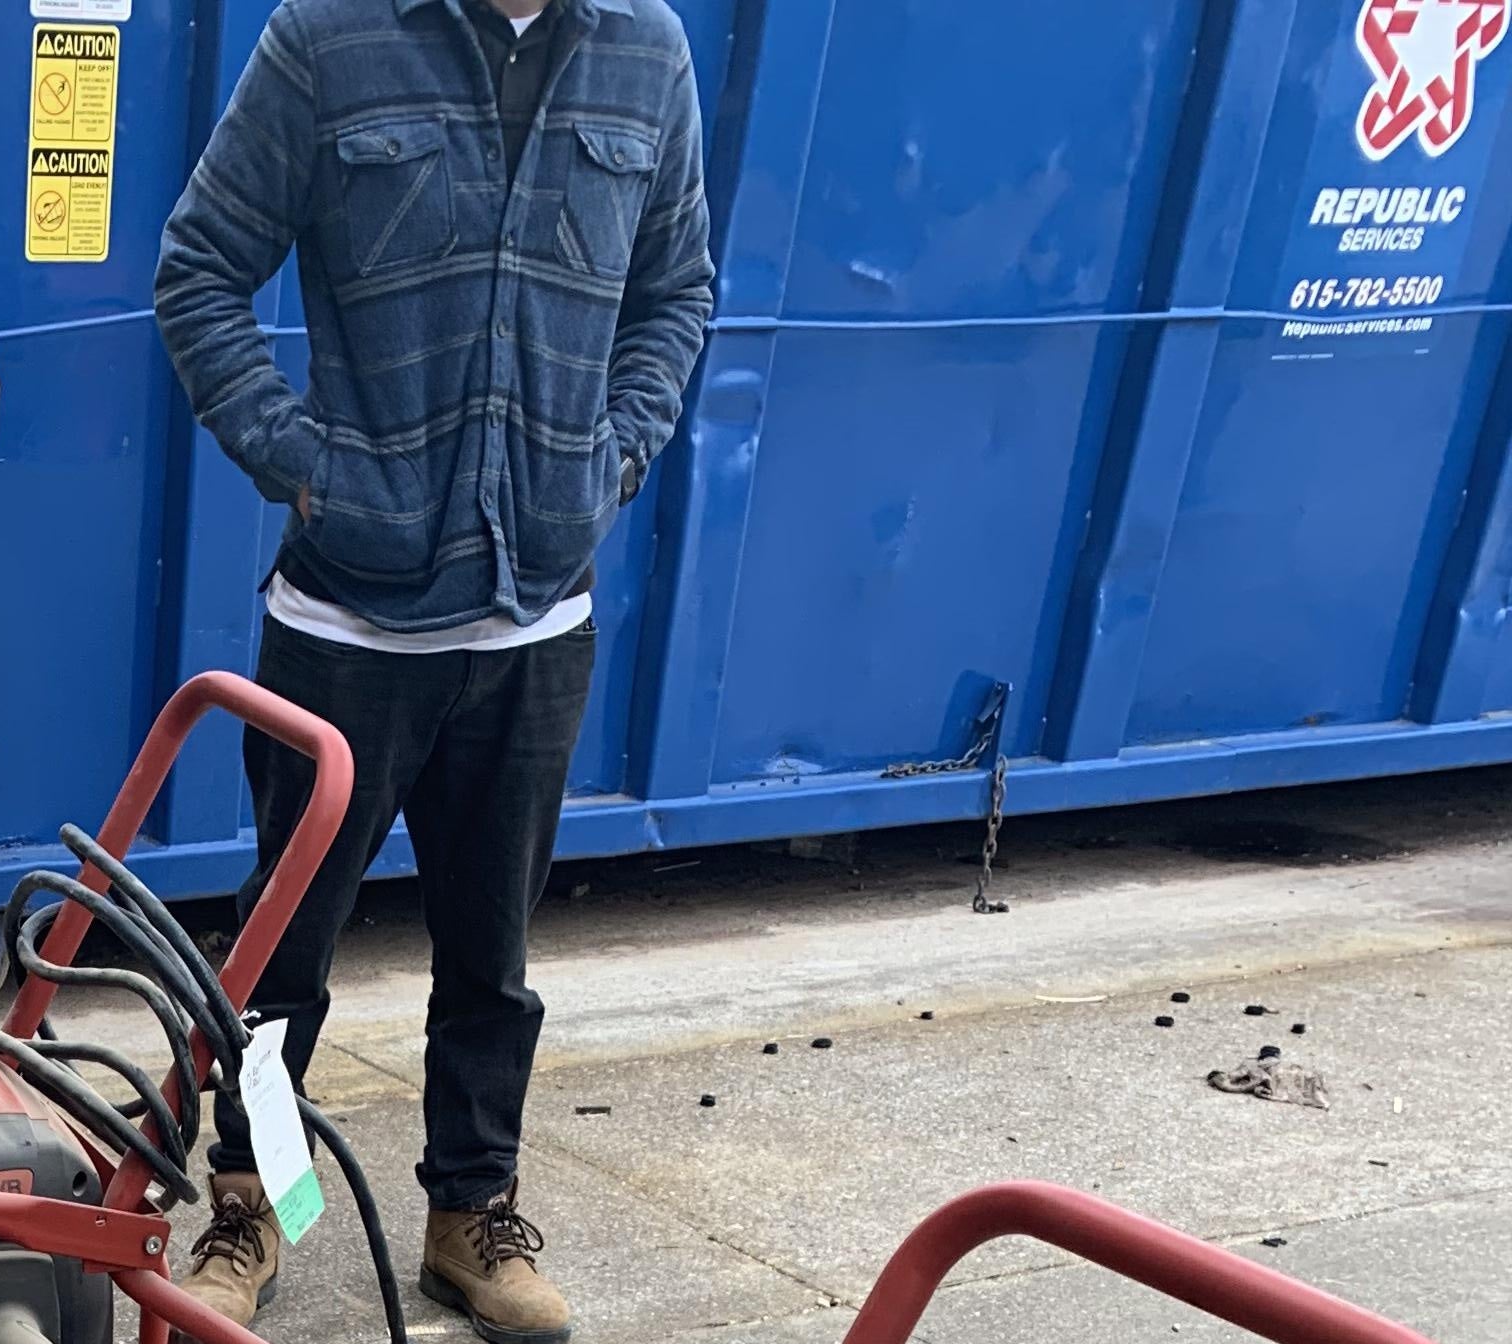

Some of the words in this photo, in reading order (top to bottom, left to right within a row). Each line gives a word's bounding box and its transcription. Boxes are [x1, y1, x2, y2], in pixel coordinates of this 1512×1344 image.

[53, 34, 115, 57] CAUTION
[48, 151, 109, 174] CAUTION
[1309, 186, 1466, 225] REPUBLIC
[1338, 226, 1425, 251] SERVICES
[1289, 275, 1444, 310] 615-782-5500
